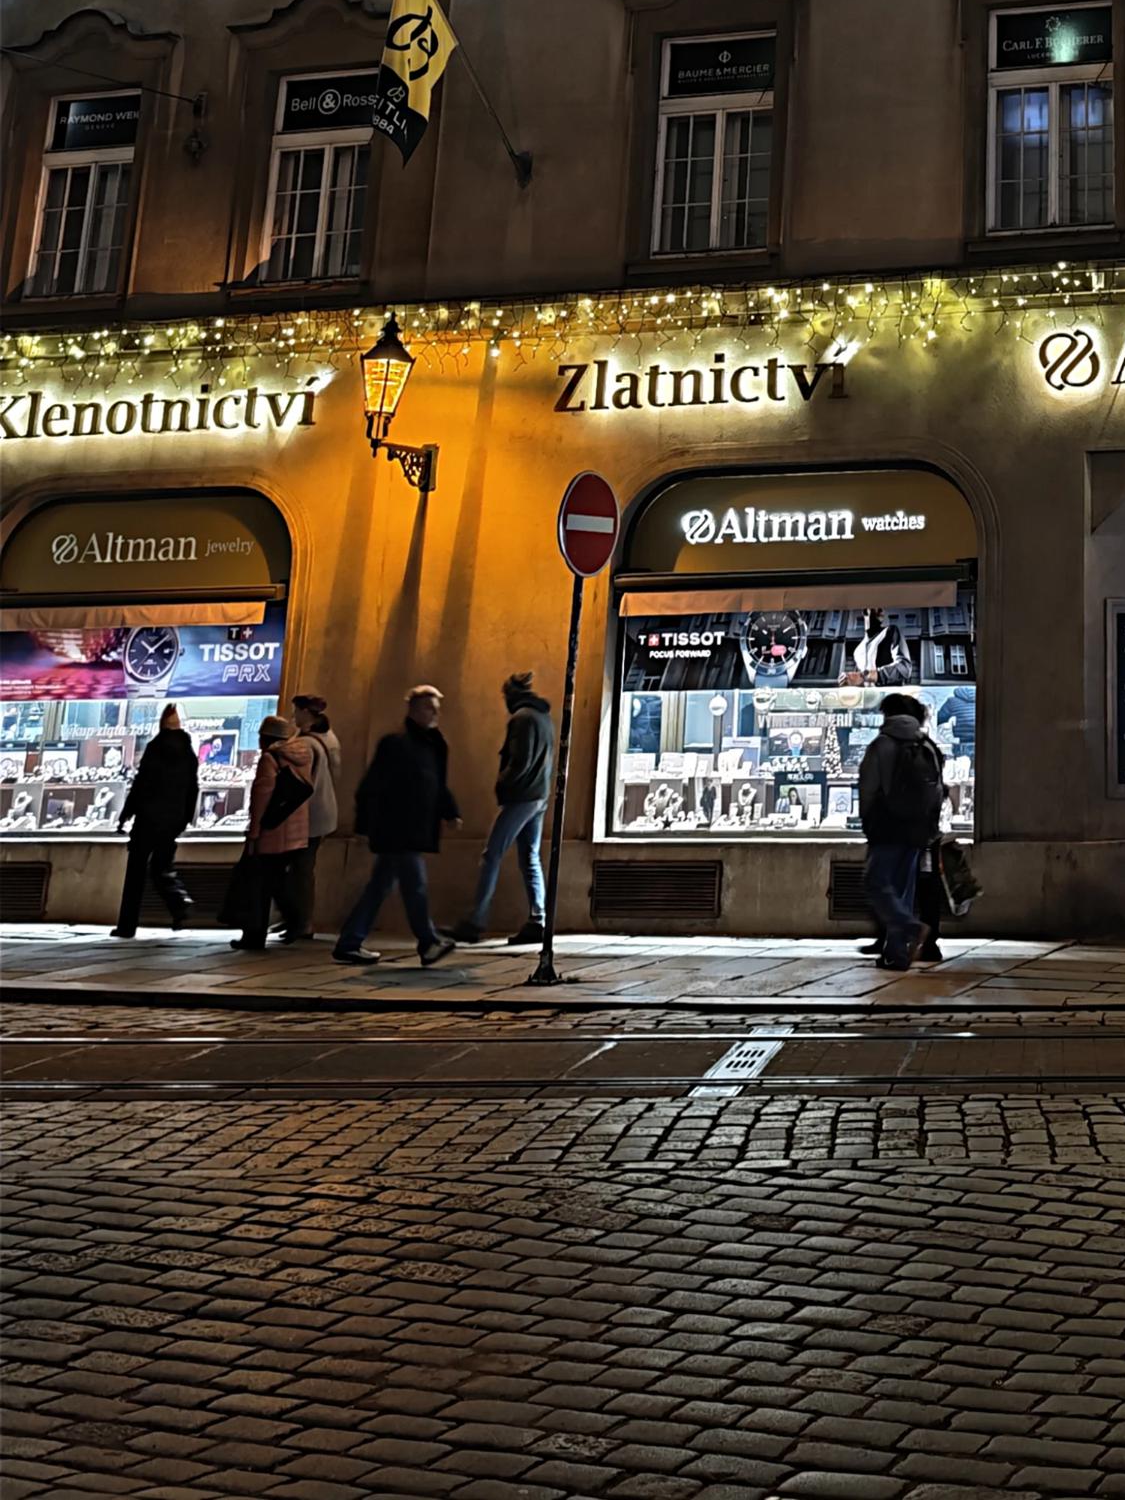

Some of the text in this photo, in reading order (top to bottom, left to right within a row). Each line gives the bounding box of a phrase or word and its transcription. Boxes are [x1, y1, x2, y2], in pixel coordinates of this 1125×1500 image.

[678, 68, 713, 79] BAUME
[715, 67, 722, 76] &
[723, 63, 770, 77] MERCIER
[291, 91, 377, 112] Bell & Ross
[60, 112, 114, 125] RAYMOND
[553, 347, 849, 412] Zlatnictví
[714, 507, 925, 543] Altman watches
[78, 532, 254, 563] Altman jewelry
[662, 632, 725, 646] TISSOT
[199, 643, 279, 662] TISSOT
[649, 649, 711, 659] FOCUS FORWARD
[222, 664, 271, 683] PRX
